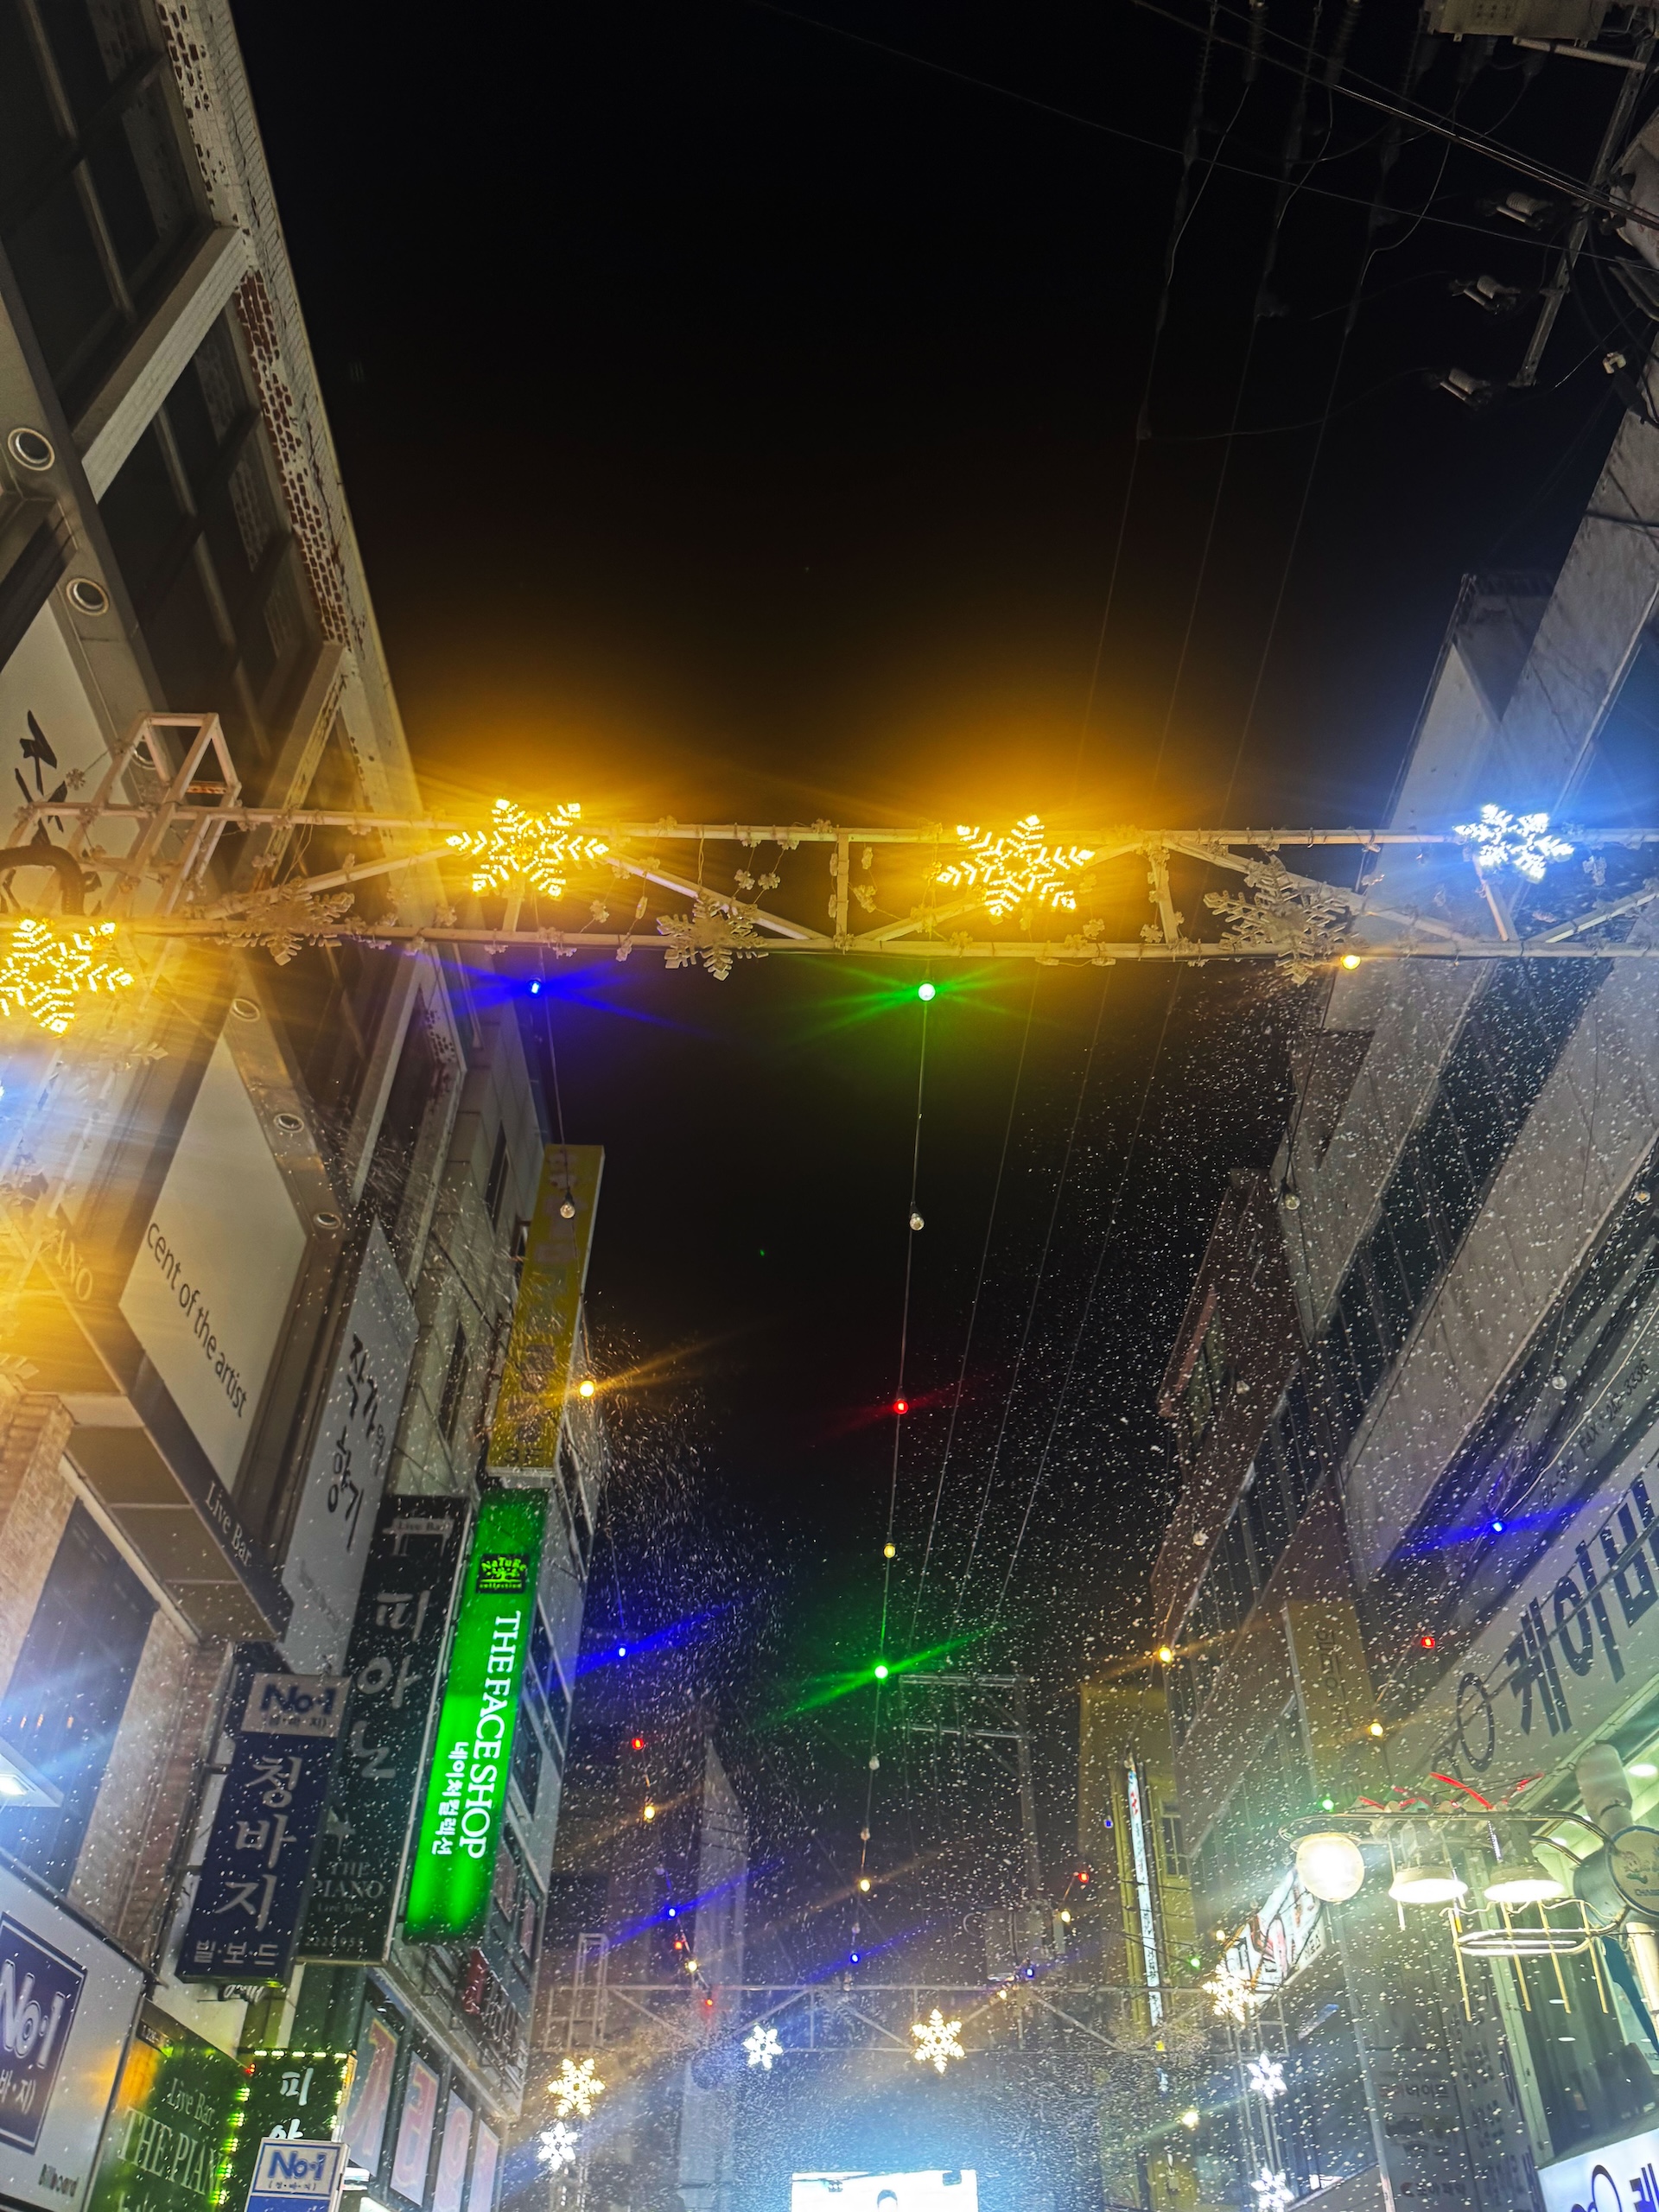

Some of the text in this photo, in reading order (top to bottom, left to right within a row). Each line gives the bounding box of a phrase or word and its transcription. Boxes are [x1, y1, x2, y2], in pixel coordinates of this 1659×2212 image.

[147, 1222, 247, 1418] cent of the artist
[205, 1479, 252, 1567] Live Bar
[349, 1588, 431, 1780] 피아노
[459, 1610, 522, 1859] THE FACE SHOP
[214, 1754, 303, 1933] 청바지
[431, 1741, 471, 1856] 네이처컬렉션
[313, 1878, 385, 1899] PIANO
[327, 1859, 372, 1878] THE
[118, 2106, 227, 2199] THE PIAN
[167, 2077, 216, 2126] Live Bar
